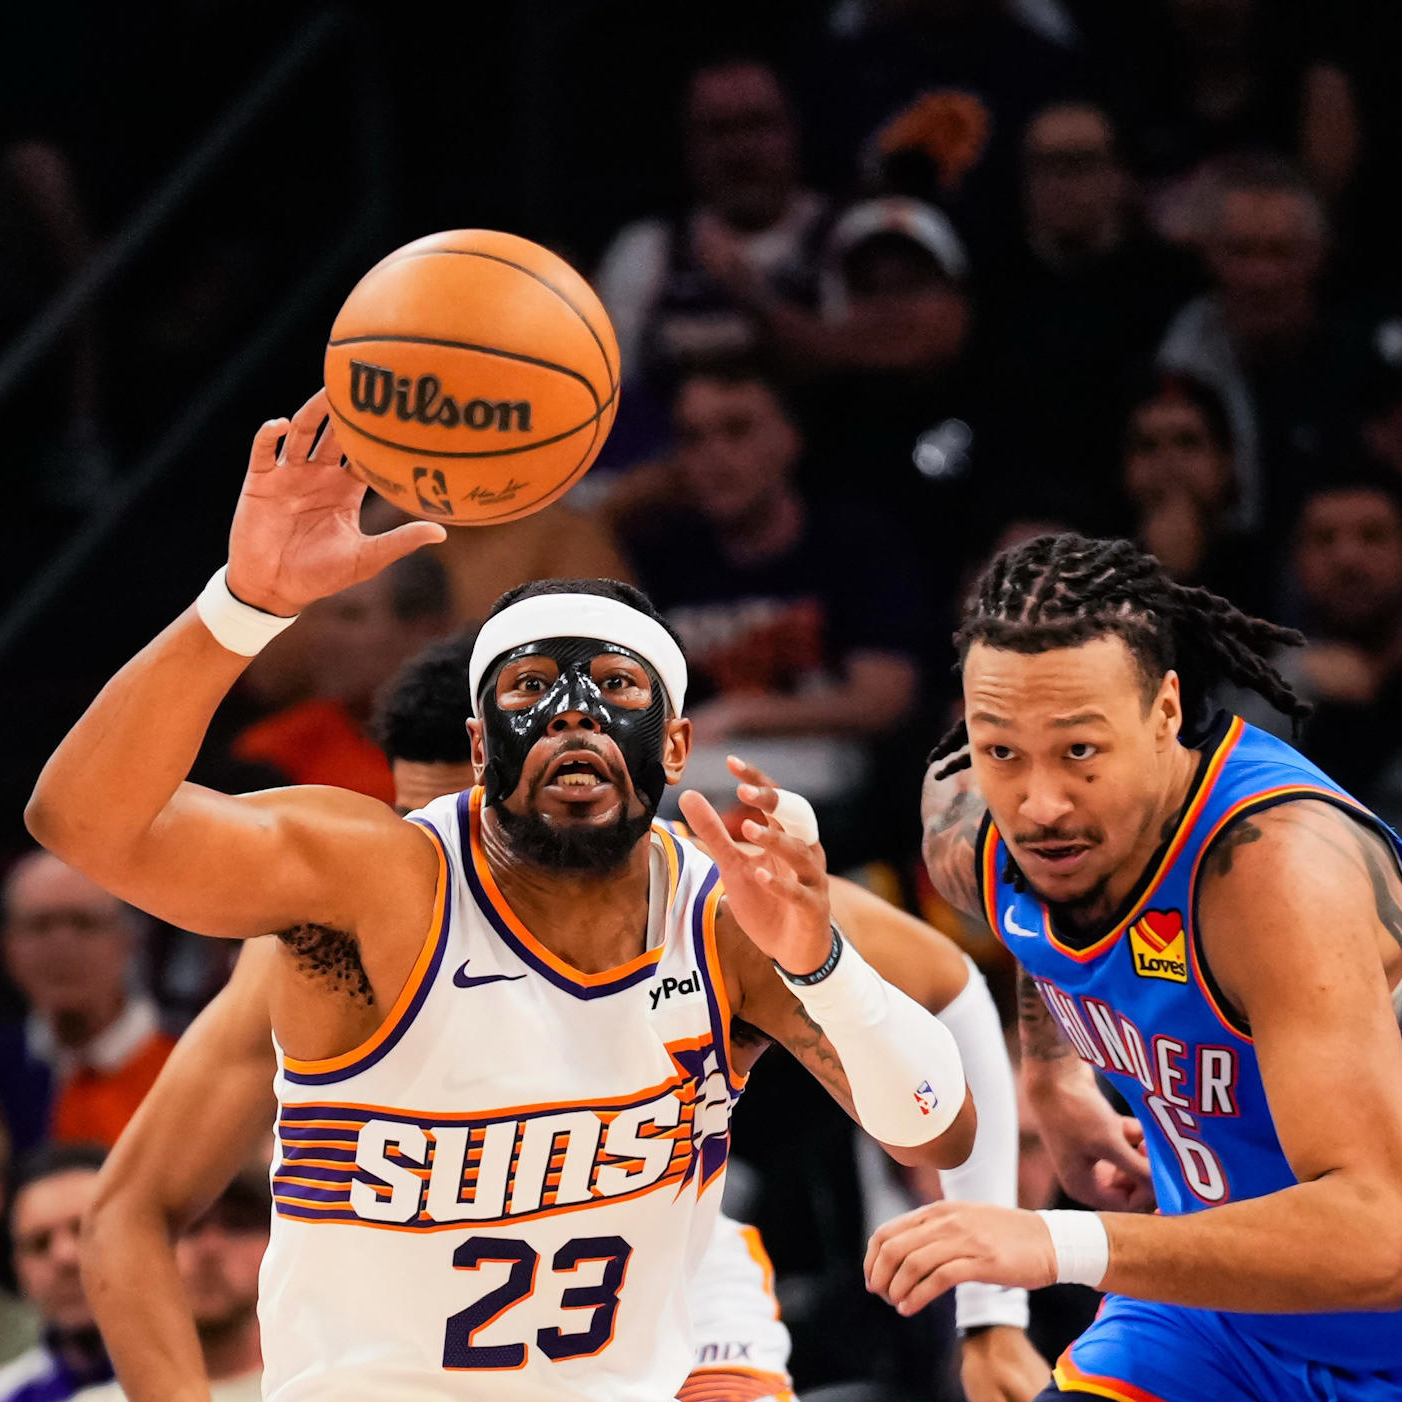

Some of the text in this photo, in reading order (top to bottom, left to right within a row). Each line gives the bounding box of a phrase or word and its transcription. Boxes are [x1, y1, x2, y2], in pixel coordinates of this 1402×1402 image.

[349, 359, 533, 432] Wilson
[649, 970, 701, 1010] yPal
[1033, 978, 1238, 1115] HUNDER
[1147, 1093, 1228, 1203] 6
[442, 1236, 634, 1371] 23
[695, 1340, 753, 1363] NIX
